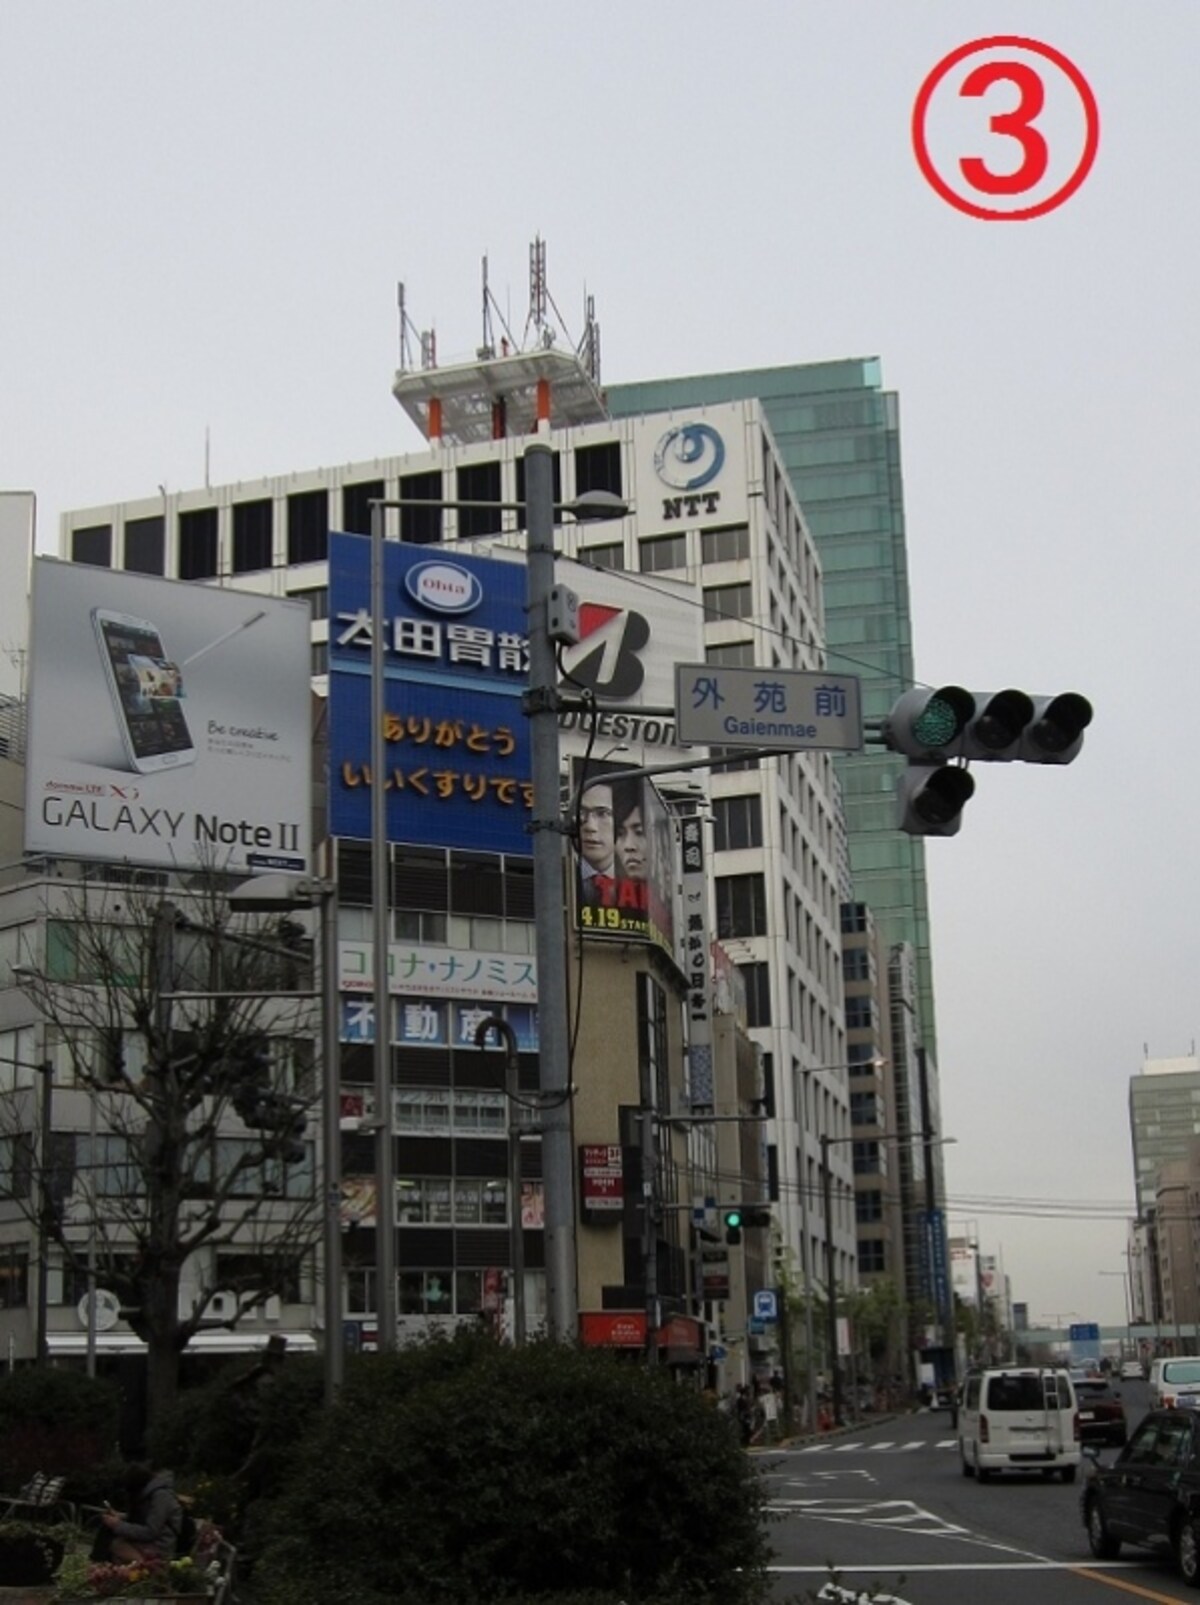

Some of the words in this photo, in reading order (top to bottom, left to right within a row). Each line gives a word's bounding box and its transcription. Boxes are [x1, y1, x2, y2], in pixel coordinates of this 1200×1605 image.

[662, 491, 721, 520] NTT
[422, 577, 466, 595] Ohta
[692, 677, 846, 718] 外苑前
[207, 720, 226, 735] Be
[384, 711, 515, 756] ありがとう
[723, 716, 818, 738] Gaienmae
[43, 797, 184, 837] GALAXY
[195, 814, 272, 848] Note
[278, 822, 299, 851] II
[582, 906, 620, 928] 4.19
[346, 1000, 497, 1042] 不動産
